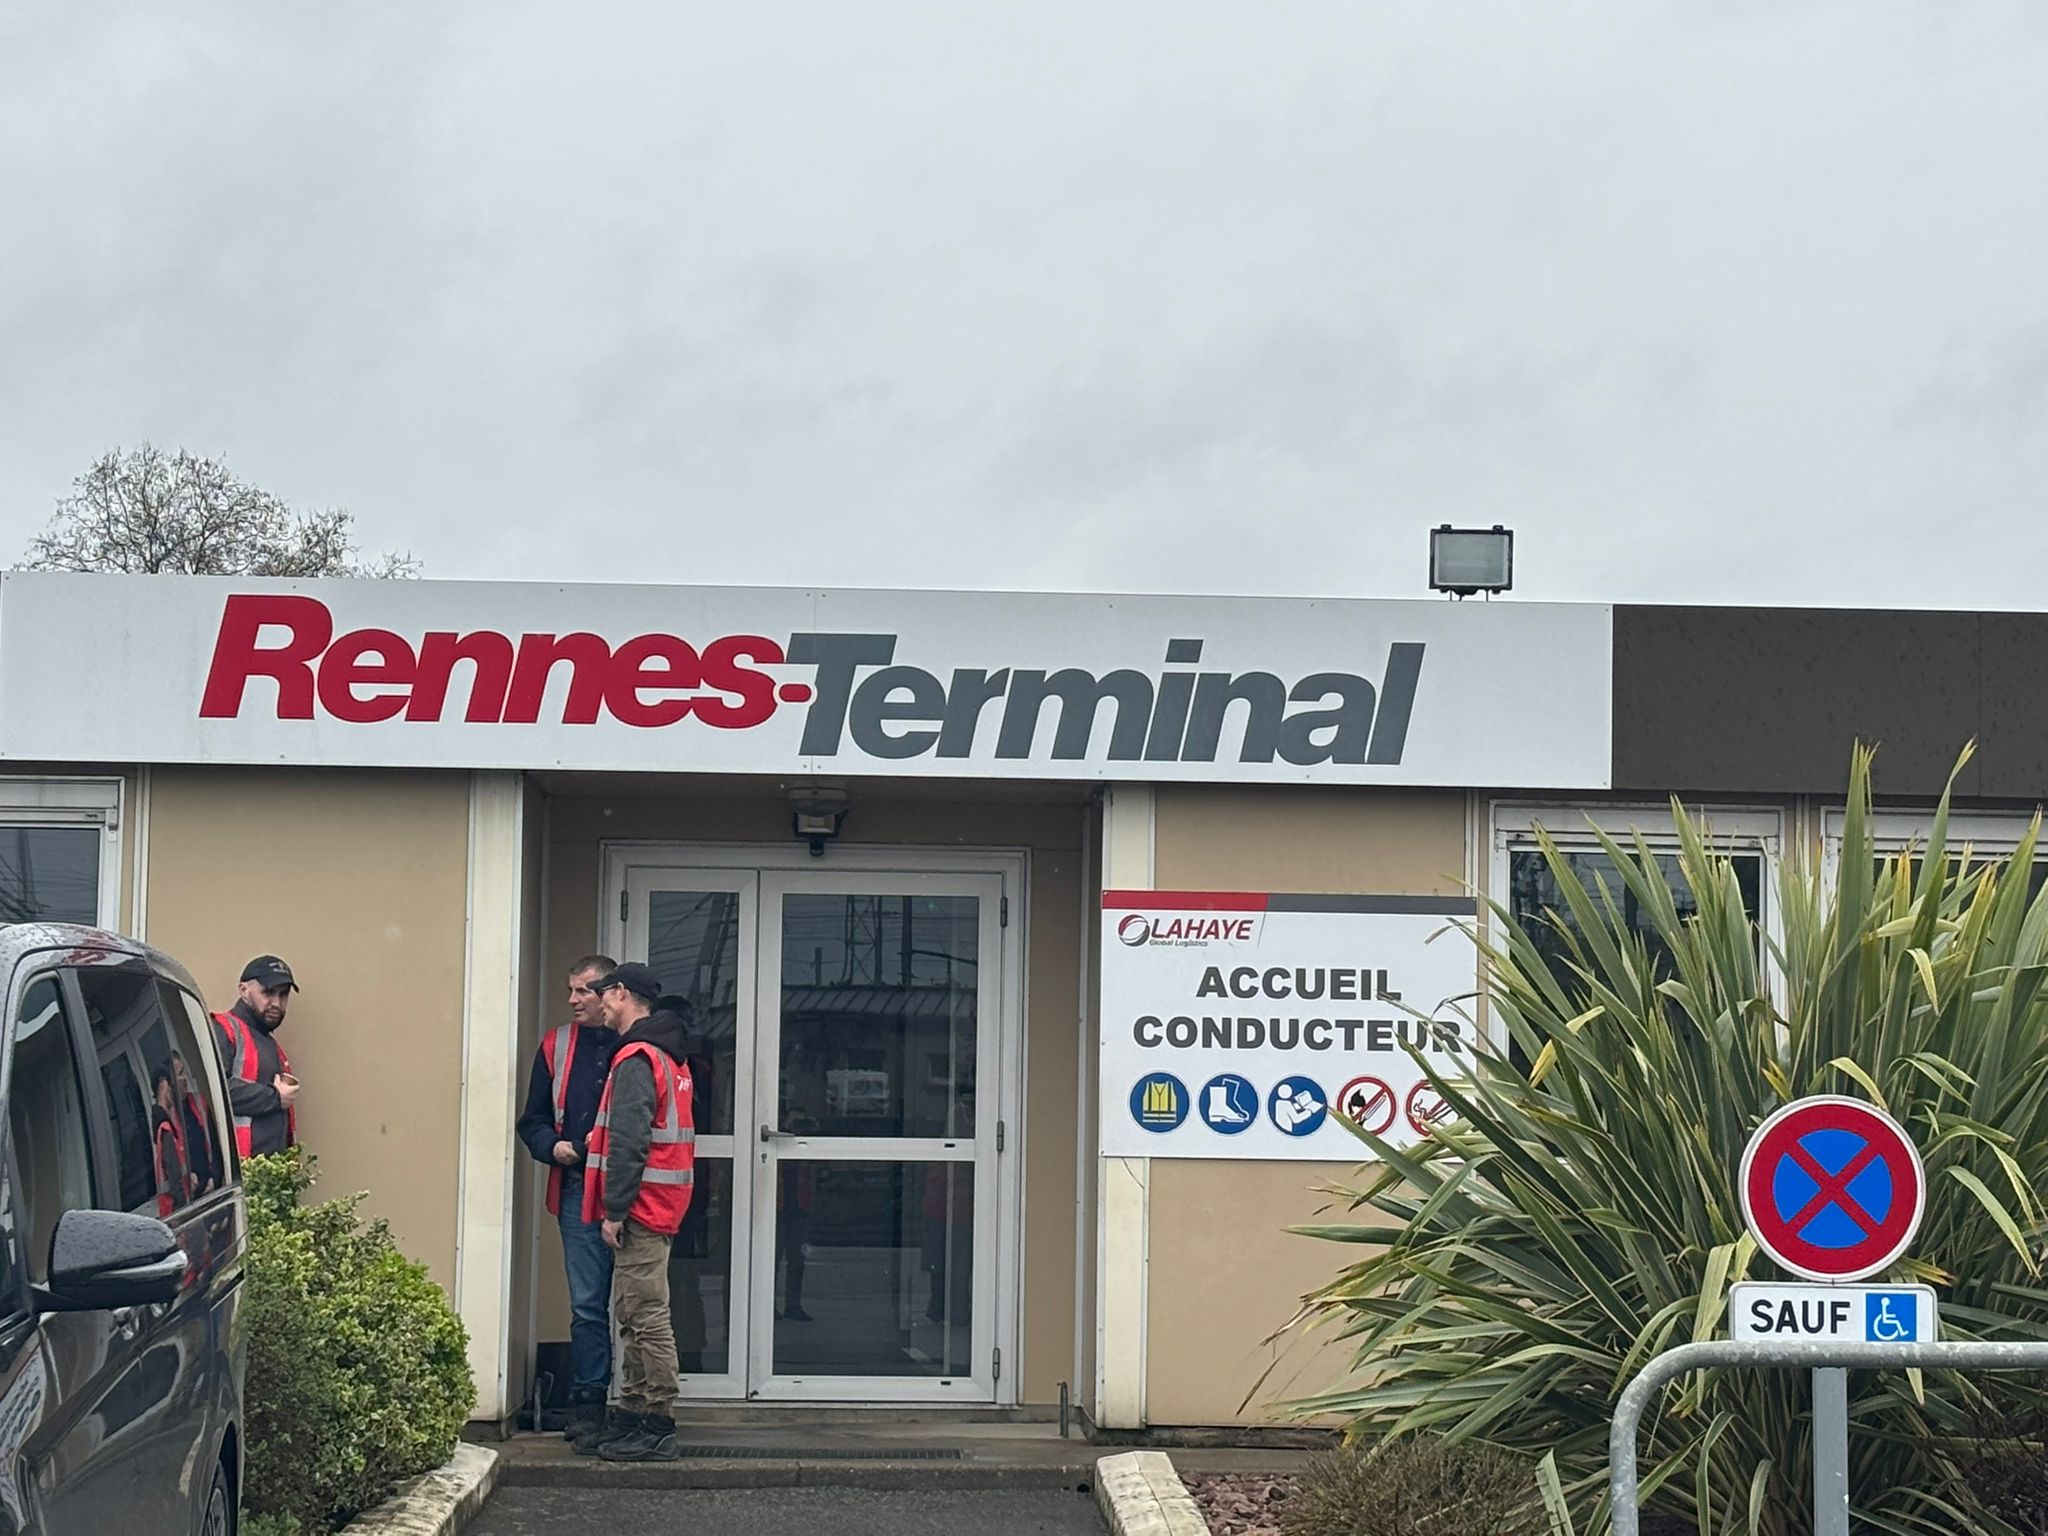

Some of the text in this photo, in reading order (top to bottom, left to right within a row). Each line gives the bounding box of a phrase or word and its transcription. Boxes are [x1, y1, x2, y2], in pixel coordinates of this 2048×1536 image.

[199, 594, 1426, 765] Rennes-Terminal
[1149, 939, 1208, 948] Global Logistics
[1151, 918, 1254, 940] LAHAYE
[1196, 966, 1401, 1000] ACCUEIL
[1133, 1015, 1462, 1053] CONDUCTEUR
[1750, 1299, 1850, 1334] SAUF
